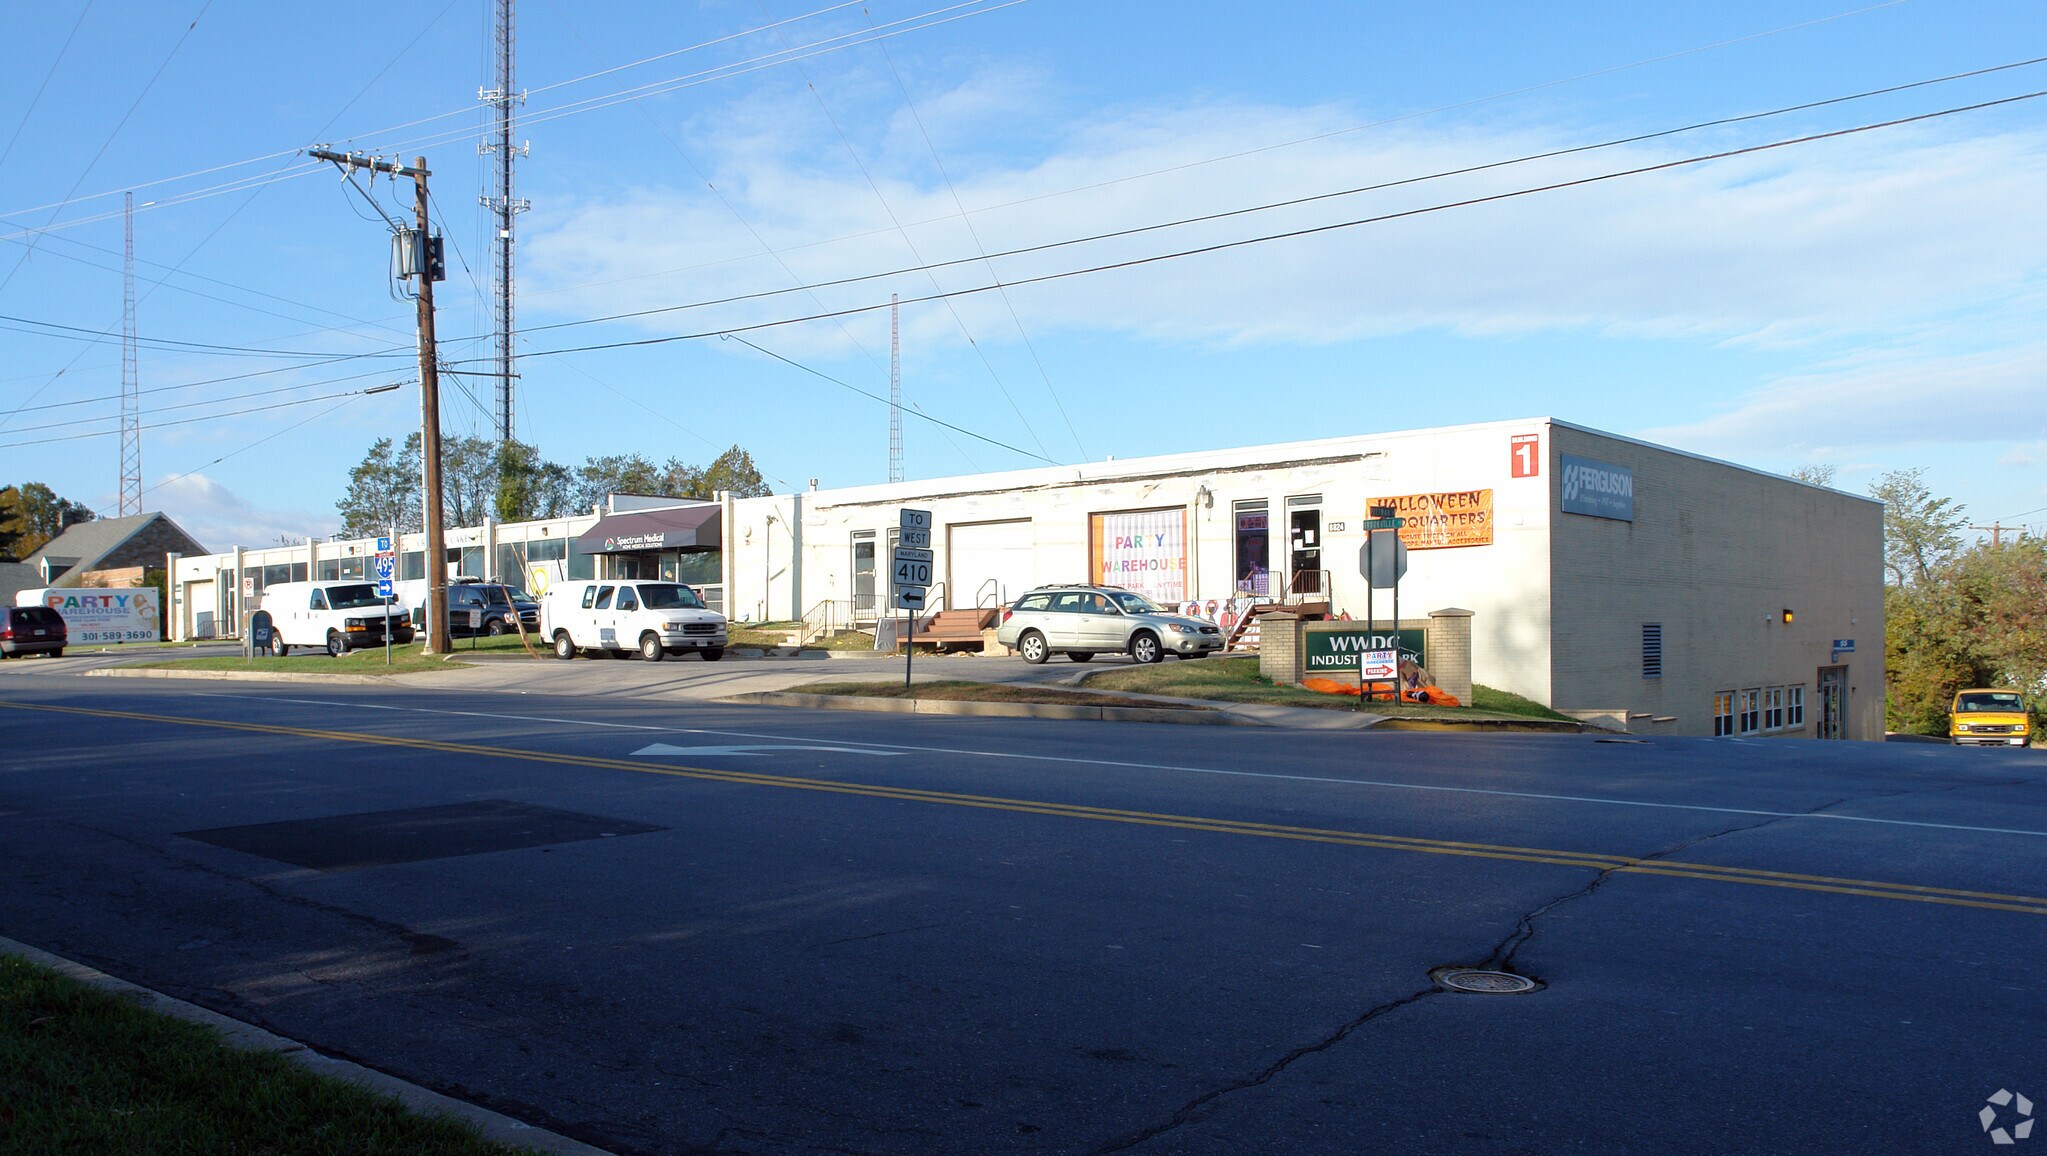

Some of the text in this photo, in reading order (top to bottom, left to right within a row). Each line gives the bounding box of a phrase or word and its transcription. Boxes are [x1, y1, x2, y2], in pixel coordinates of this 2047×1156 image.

[1515, 444, 1531, 475] 1
[1580, 466, 1632, 497] FERGUSON
[909, 513, 923, 525] TO
[1401, 511, 1486, 529] DQUARTERS
[450, 535, 469, 544] CAKE
[616, 532, 665, 547] Spectrum Medical
[904, 532, 926, 544] WEST
[1115, 533, 1165, 550] PARTY
[900, 550, 928, 559] MARYLAND
[376, 557, 394, 573] 495
[898, 563, 928, 581] 410
[1102, 557, 1186, 573] WAREHOUSE
[47, 595, 129, 608] PARTY
[1311, 654, 1359, 666] INDUST
